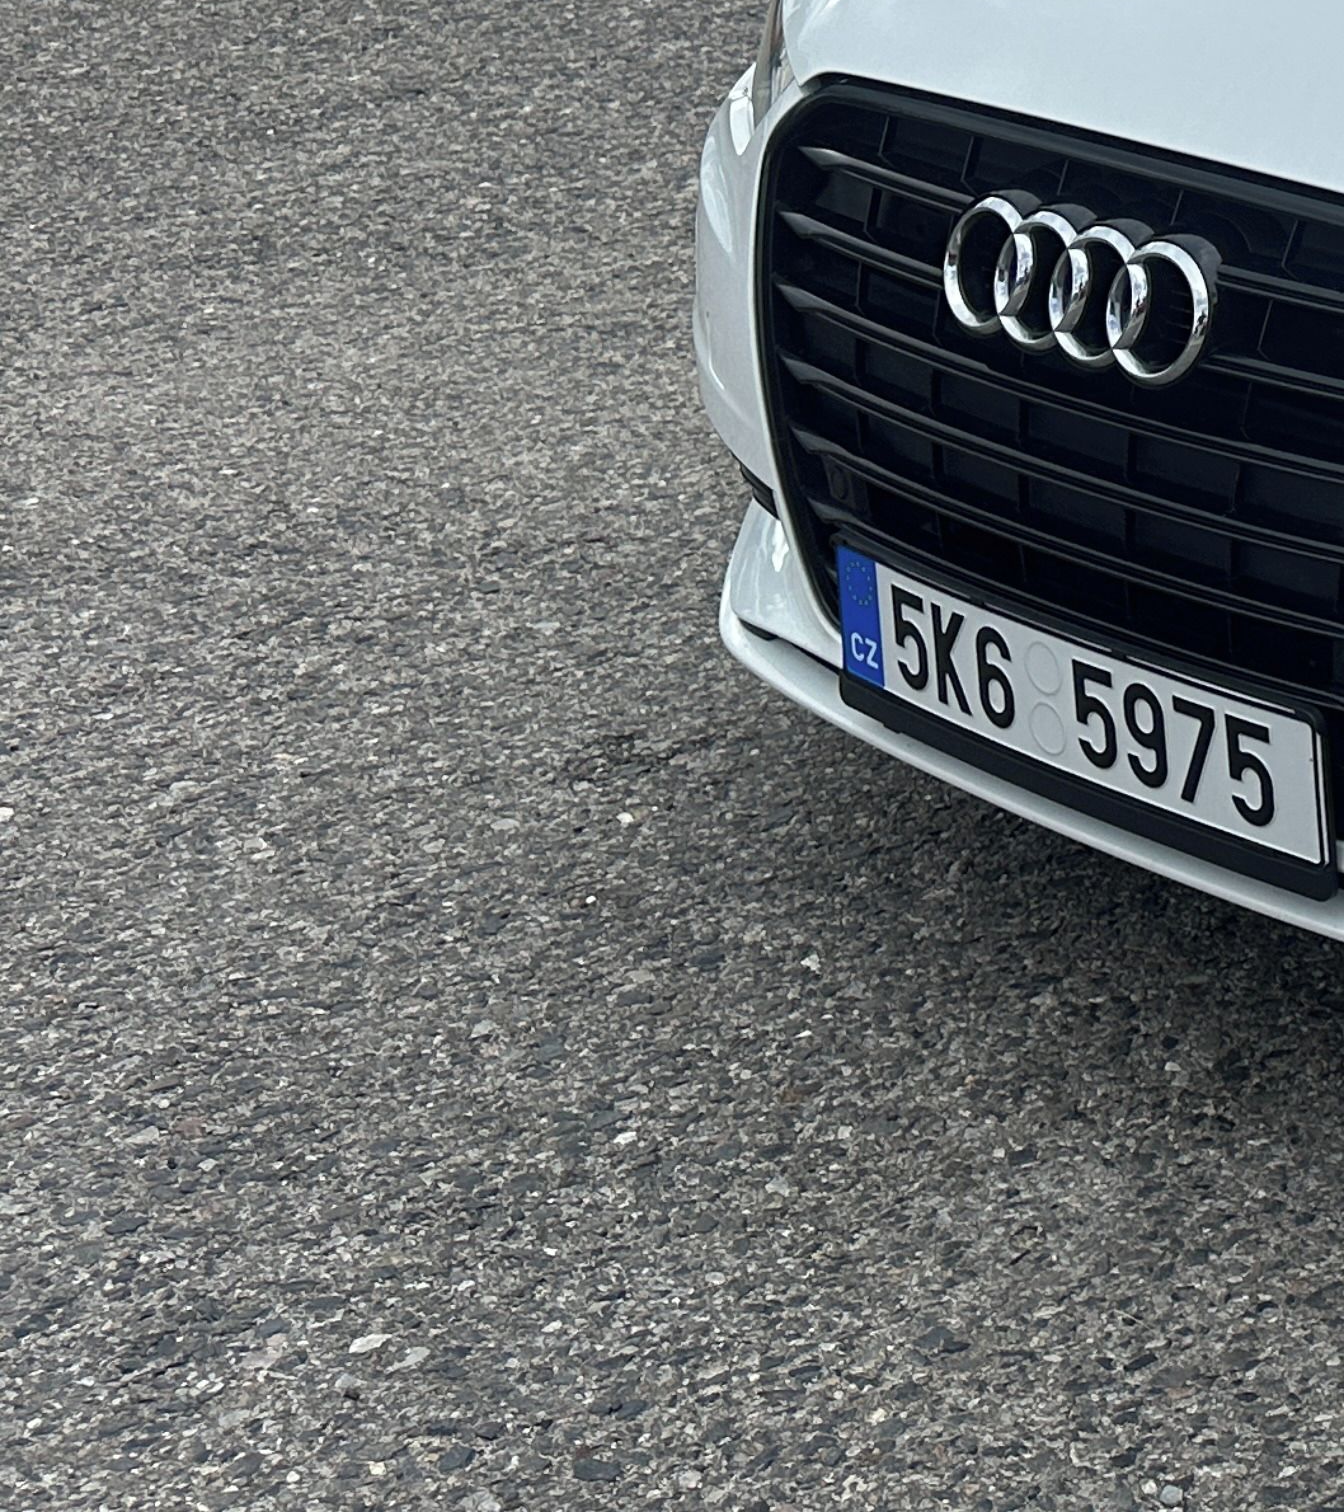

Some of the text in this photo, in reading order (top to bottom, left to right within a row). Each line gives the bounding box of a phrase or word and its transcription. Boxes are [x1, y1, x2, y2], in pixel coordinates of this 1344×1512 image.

[851, 631, 880, 670] CZ
[890, 583, 1275, 827] 5K6 5975
